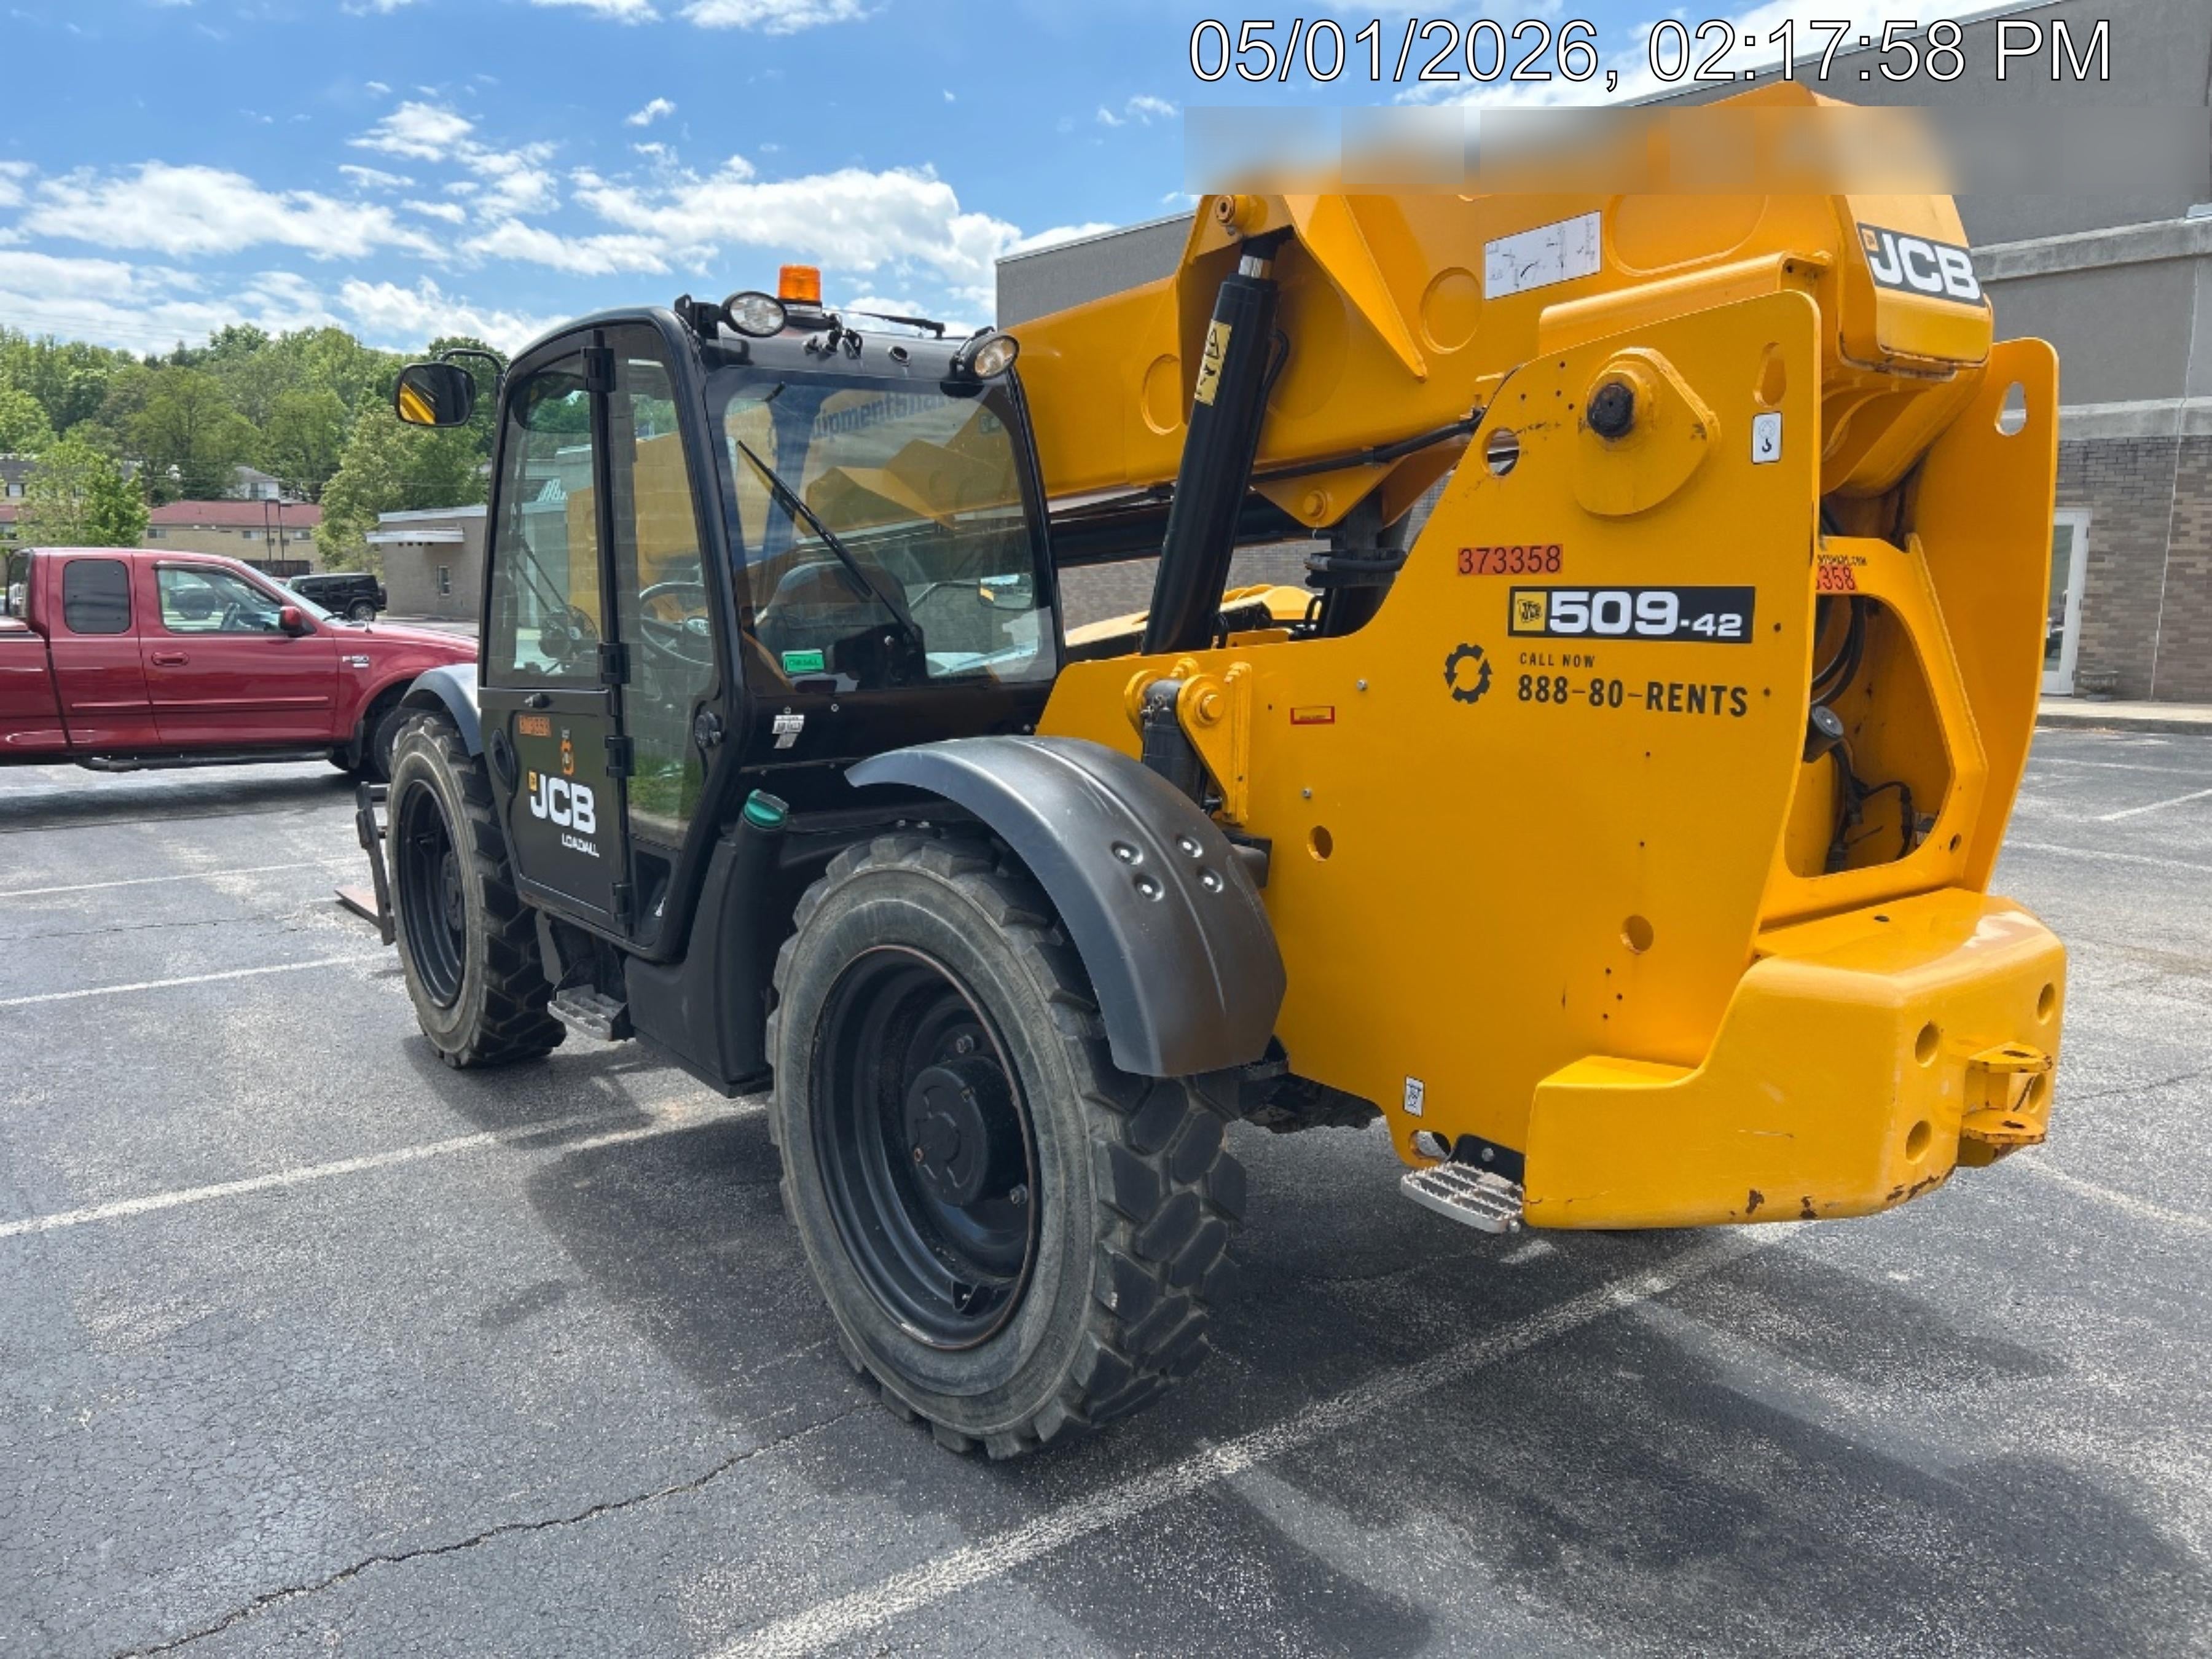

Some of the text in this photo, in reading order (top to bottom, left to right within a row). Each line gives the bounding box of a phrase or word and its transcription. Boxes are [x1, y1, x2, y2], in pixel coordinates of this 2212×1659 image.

[1869, 232, 1981, 300] JCB
[1459, 544, 1561, 575] 373358
[1816, 565, 1856, 590] 358
[1549, 590, 1743, 637] 509-42
[1519, 652, 1596, 668] CALL NOW
[1518, 674, 1748, 718] 888-80-RENTS
[530, 773, 597, 834] JCB
[561, 832, 600, 858] LOADALL
